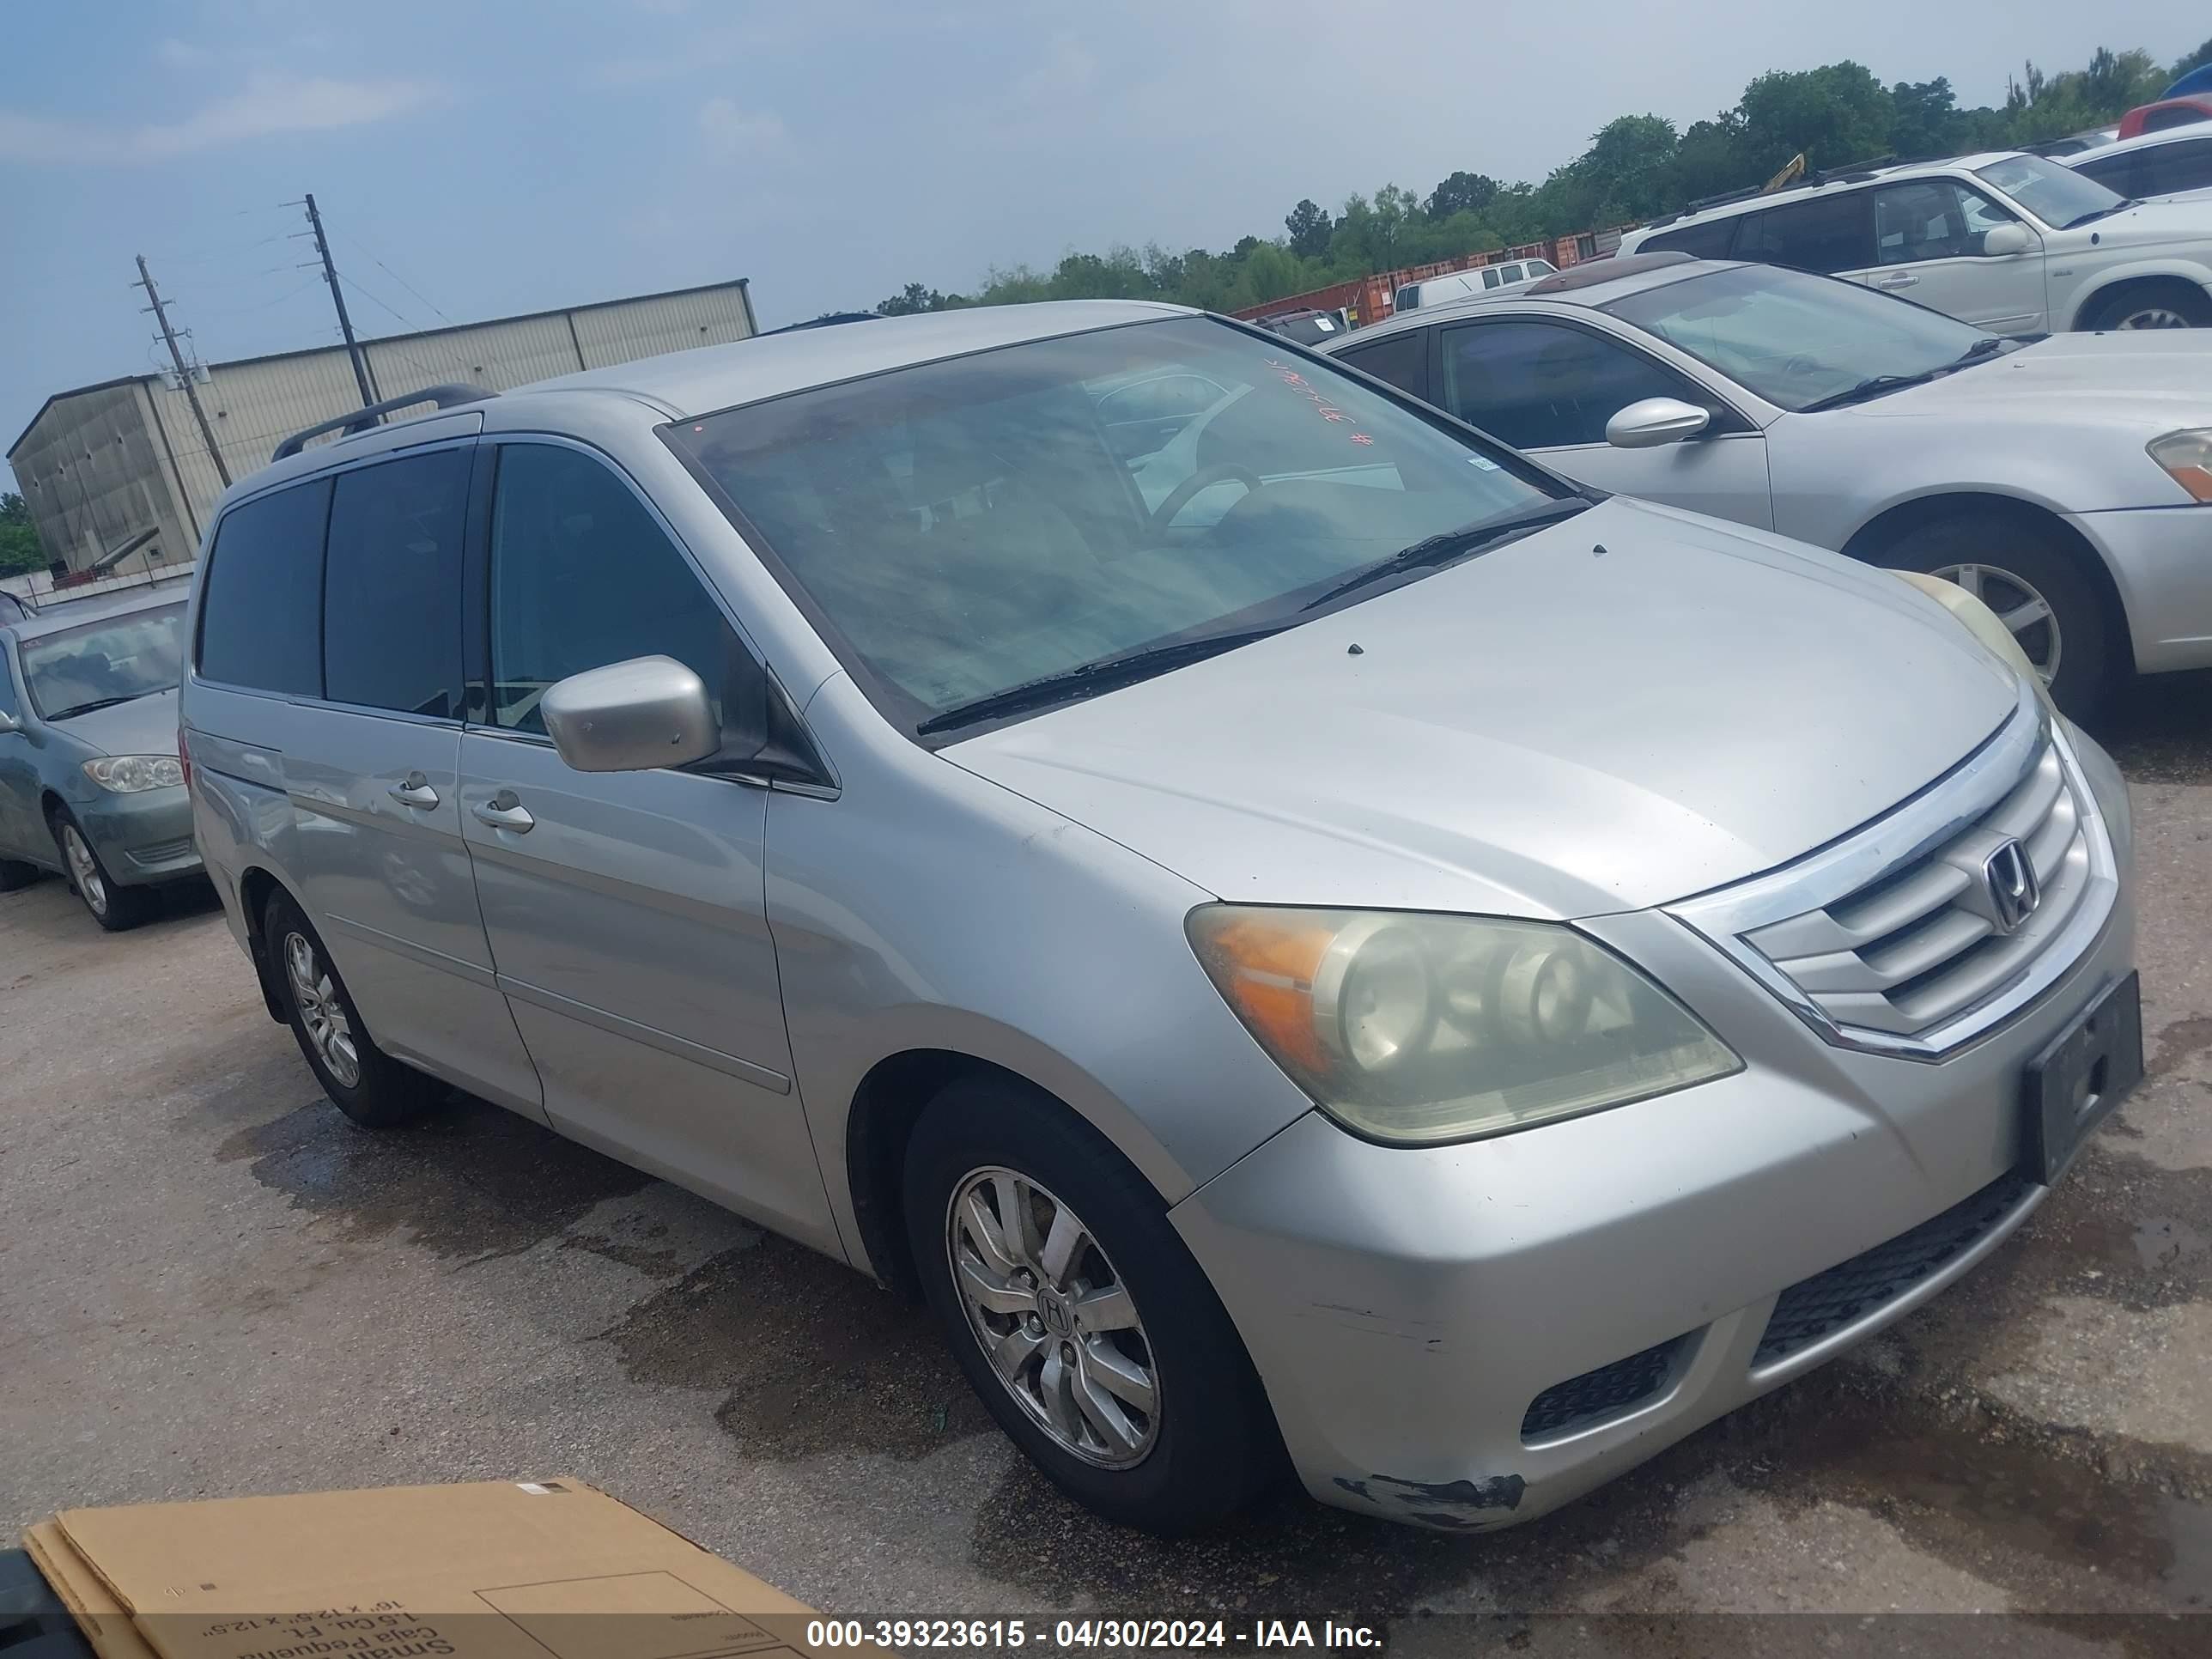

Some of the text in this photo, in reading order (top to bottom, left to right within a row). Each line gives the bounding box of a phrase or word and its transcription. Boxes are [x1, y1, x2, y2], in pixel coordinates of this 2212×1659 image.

[281, 1612, 420, 1638] 1.5 Cu. Ft.
[374, 1626, 439, 1644] Caja
